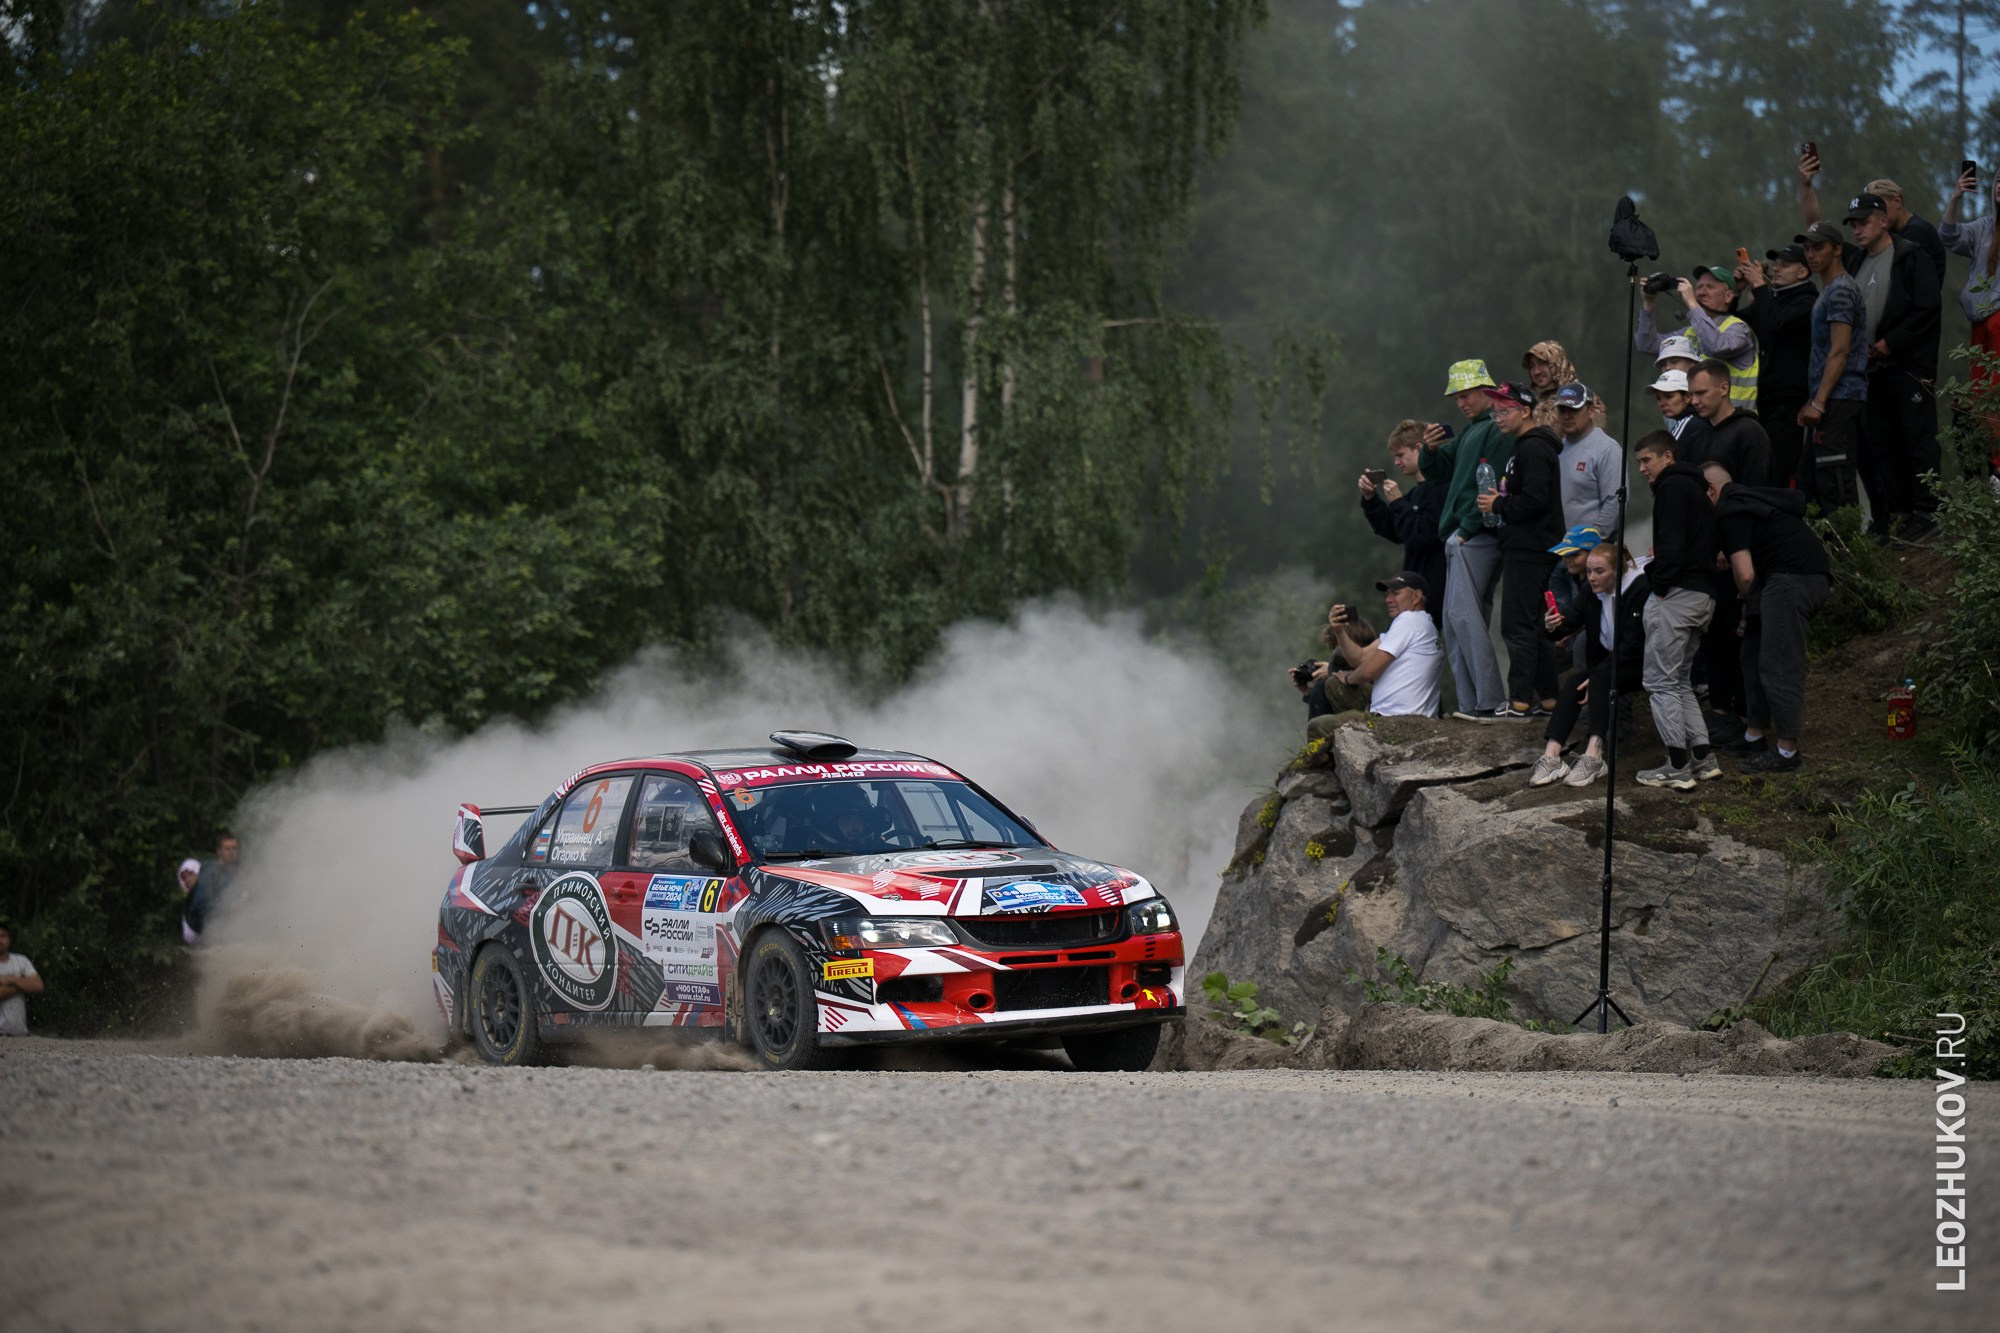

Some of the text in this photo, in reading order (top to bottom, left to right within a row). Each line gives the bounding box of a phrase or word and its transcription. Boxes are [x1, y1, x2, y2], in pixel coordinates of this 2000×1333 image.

[743, 763, 926, 780] РАЛЛИ РОССИИ
[734, 787, 754, 804] 6
[583, 779, 609, 833] 6
[555, 829, 603, 846] Украинец А.
[551, 846, 587, 864] Огарко К.
[665, 892, 682, 901] 2024
[703, 880, 719, 912] 6
[553, 880, 611, 940] ПРИМОРСКИЙ
[661, 918, 690, 930] РАЛЛИ
[660, 929, 694, 941] РОССИИ
[667, 963, 714, 977] СИТИДРАЙВ
[827, 962, 868, 977] PIRELLI
[546, 959, 595, 1001] КОНДИТЕР
[677, 993, 711, 1002] www.staf.ru
